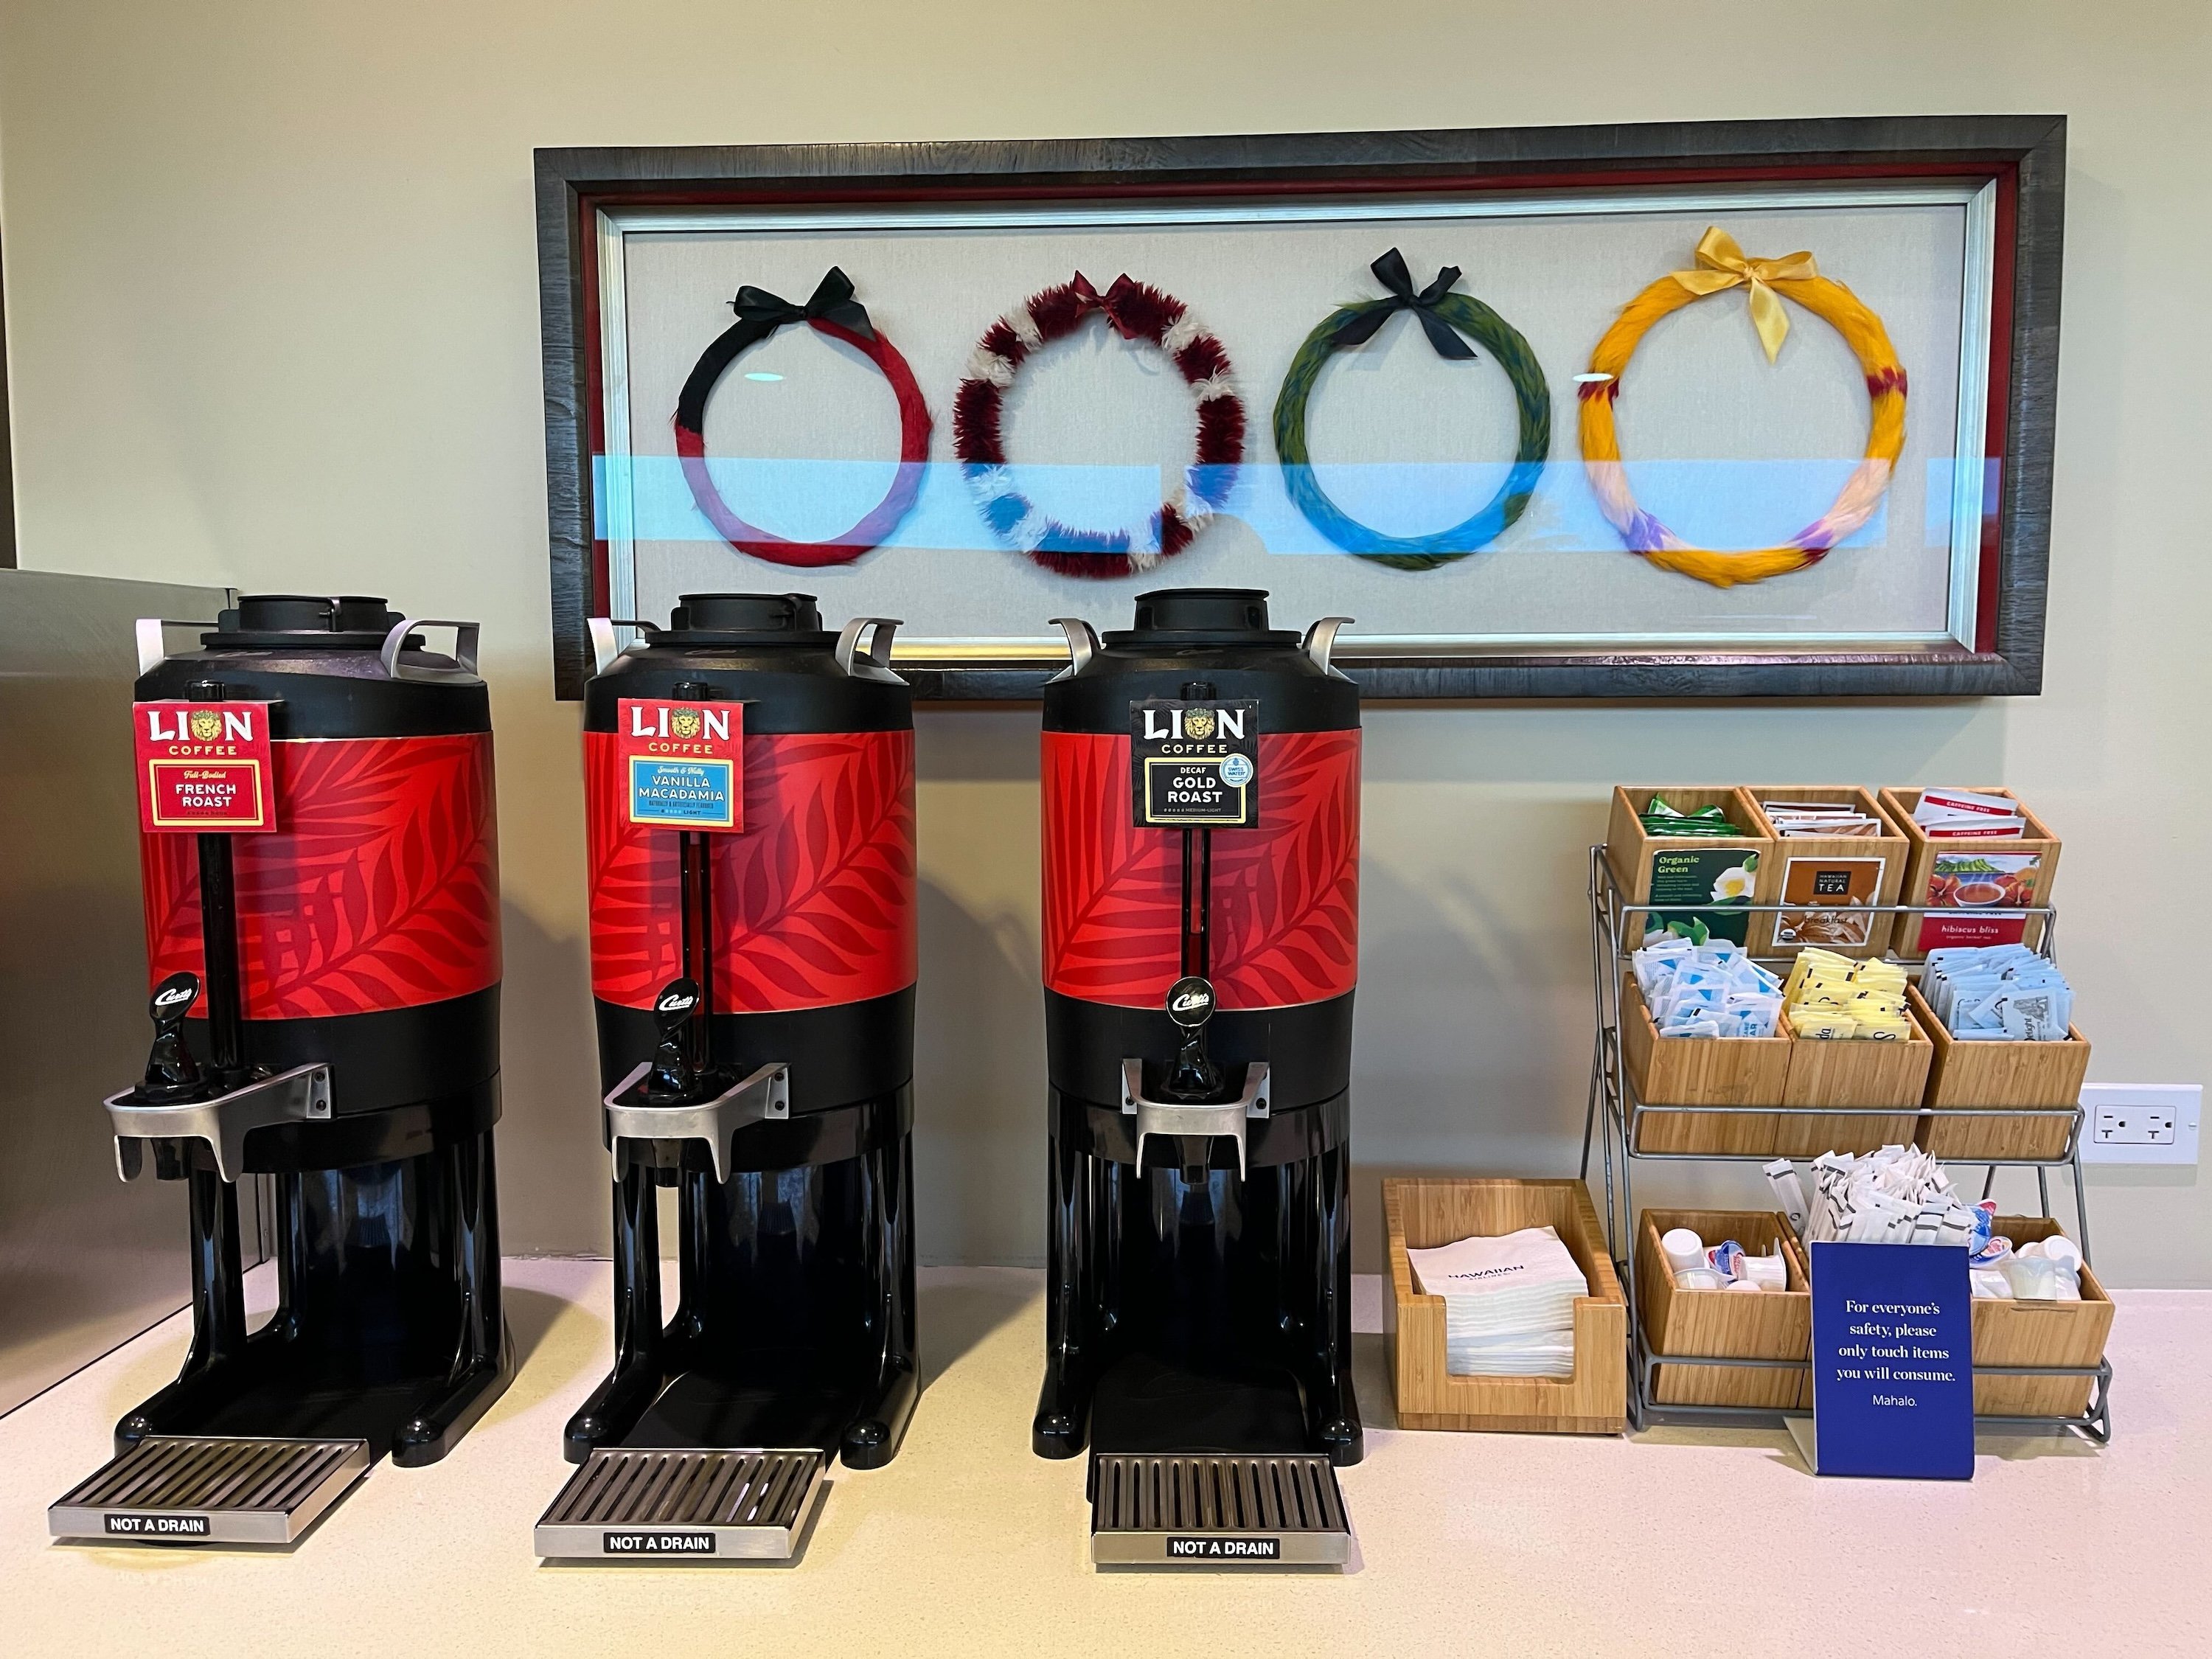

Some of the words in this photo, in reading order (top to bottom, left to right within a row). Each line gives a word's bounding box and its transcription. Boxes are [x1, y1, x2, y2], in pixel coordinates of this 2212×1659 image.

[168, 745, 237, 755] COFFEE
[648, 742, 713, 754] COFFEE
[1161, 744, 1228, 754] COFFEE
[652, 775, 710, 788] VANILLA
[1172, 776, 1217, 789] GOLD
[175, 784, 236, 795] FRENCH
[639, 787, 726, 801] MACADAMIA
[182, 796, 232, 807] ROAST
[1167, 790, 1223, 803] ROAST
[1946, 801, 1975, 810] CAFFEINE
[1659, 855, 1700, 866] Organic
[1818, 884, 1844, 892] TEA
[1804, 915, 1848, 925] breakfast
[1941, 925, 1976, 933] hibiscus
[1172, 992, 1209, 1011] Cutis
[1448, 1265, 1524, 1279] HAWAIIAN
[1846, 1300, 1869, 1313] For
[1849, 1322, 1892, 1338] safety,
[1895, 1323, 1937, 1338] please
[1838, 1343, 1868, 1360] only
[1871, 1345, 1909, 1358] touch
[1913, 1346, 1950, 1359] items
[1837, 1368, 1861, 1381] you
[1864, 1366, 1890, 1380] will
[1893, 1371, 1955, 1382] consume.
[1873, 1394, 1917, 1407] Mahalo.
[111, 1517, 142, 1531] NOT
[145, 1519, 156, 1531] A
[158, 1519, 204, 1532] DRAIN
[610, 1536, 643, 1550] NOT
[646, 1537, 658, 1550] A
[661, 1537, 709, 1550] DRAIN
[1173, 1541, 1206, 1554] NOT
[1209, 1541, 1221, 1554] A
[1224, 1542, 1273, 1555] DRAIN
